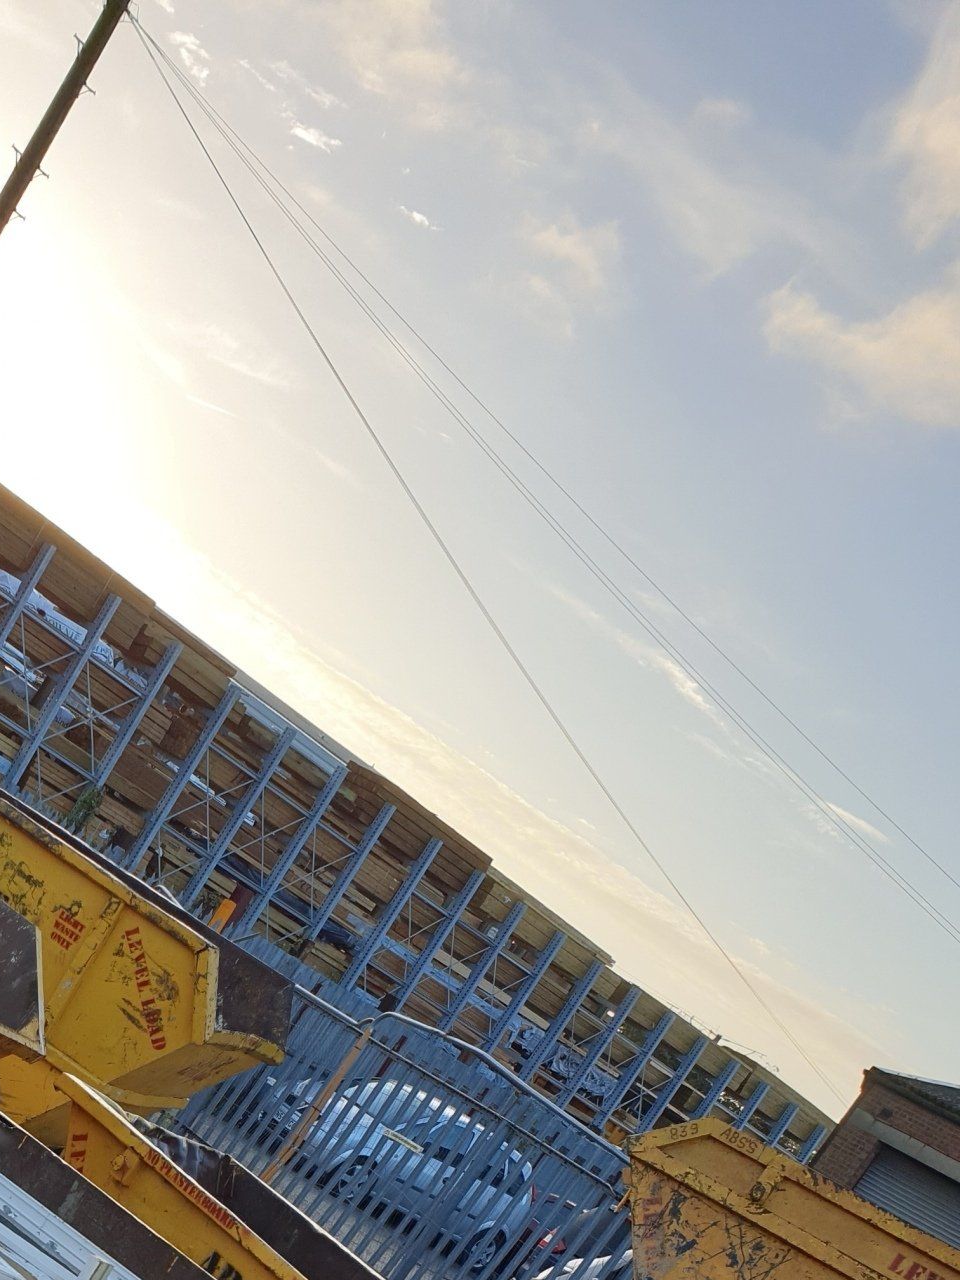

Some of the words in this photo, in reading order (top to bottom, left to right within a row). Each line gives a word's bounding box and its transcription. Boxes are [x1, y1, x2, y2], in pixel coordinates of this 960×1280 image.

[53, 919, 81, 942] WASTE
[58, 909, 86, 934] LIGHT
[50, 931, 73, 950] ONLY
[125, 926, 152, 993] LEVEL
[141, 997, 166, 1051] LOAD
